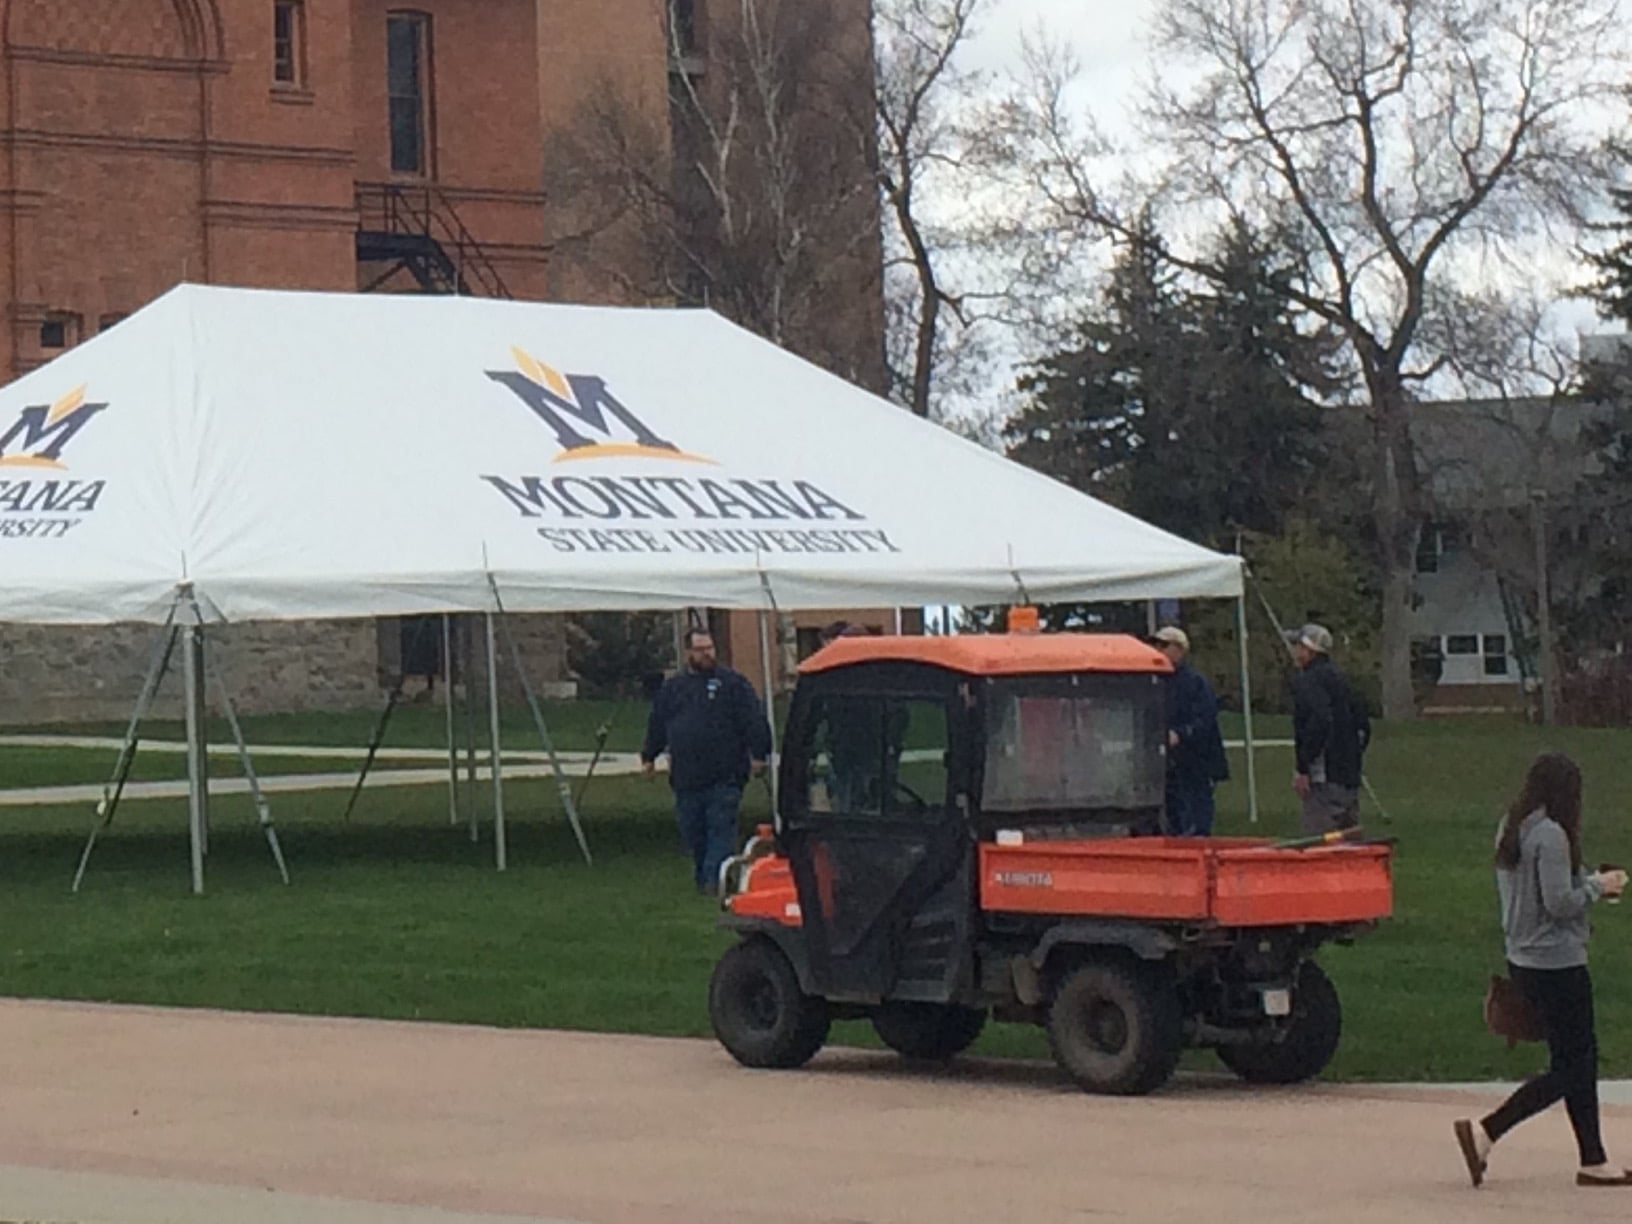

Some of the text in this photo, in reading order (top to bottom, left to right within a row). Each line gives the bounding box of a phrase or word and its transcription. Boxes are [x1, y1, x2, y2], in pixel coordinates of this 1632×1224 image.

[479, 475, 867, 520] MONTANA
[537, 527, 902, 554] STATE UNIVERSITY
